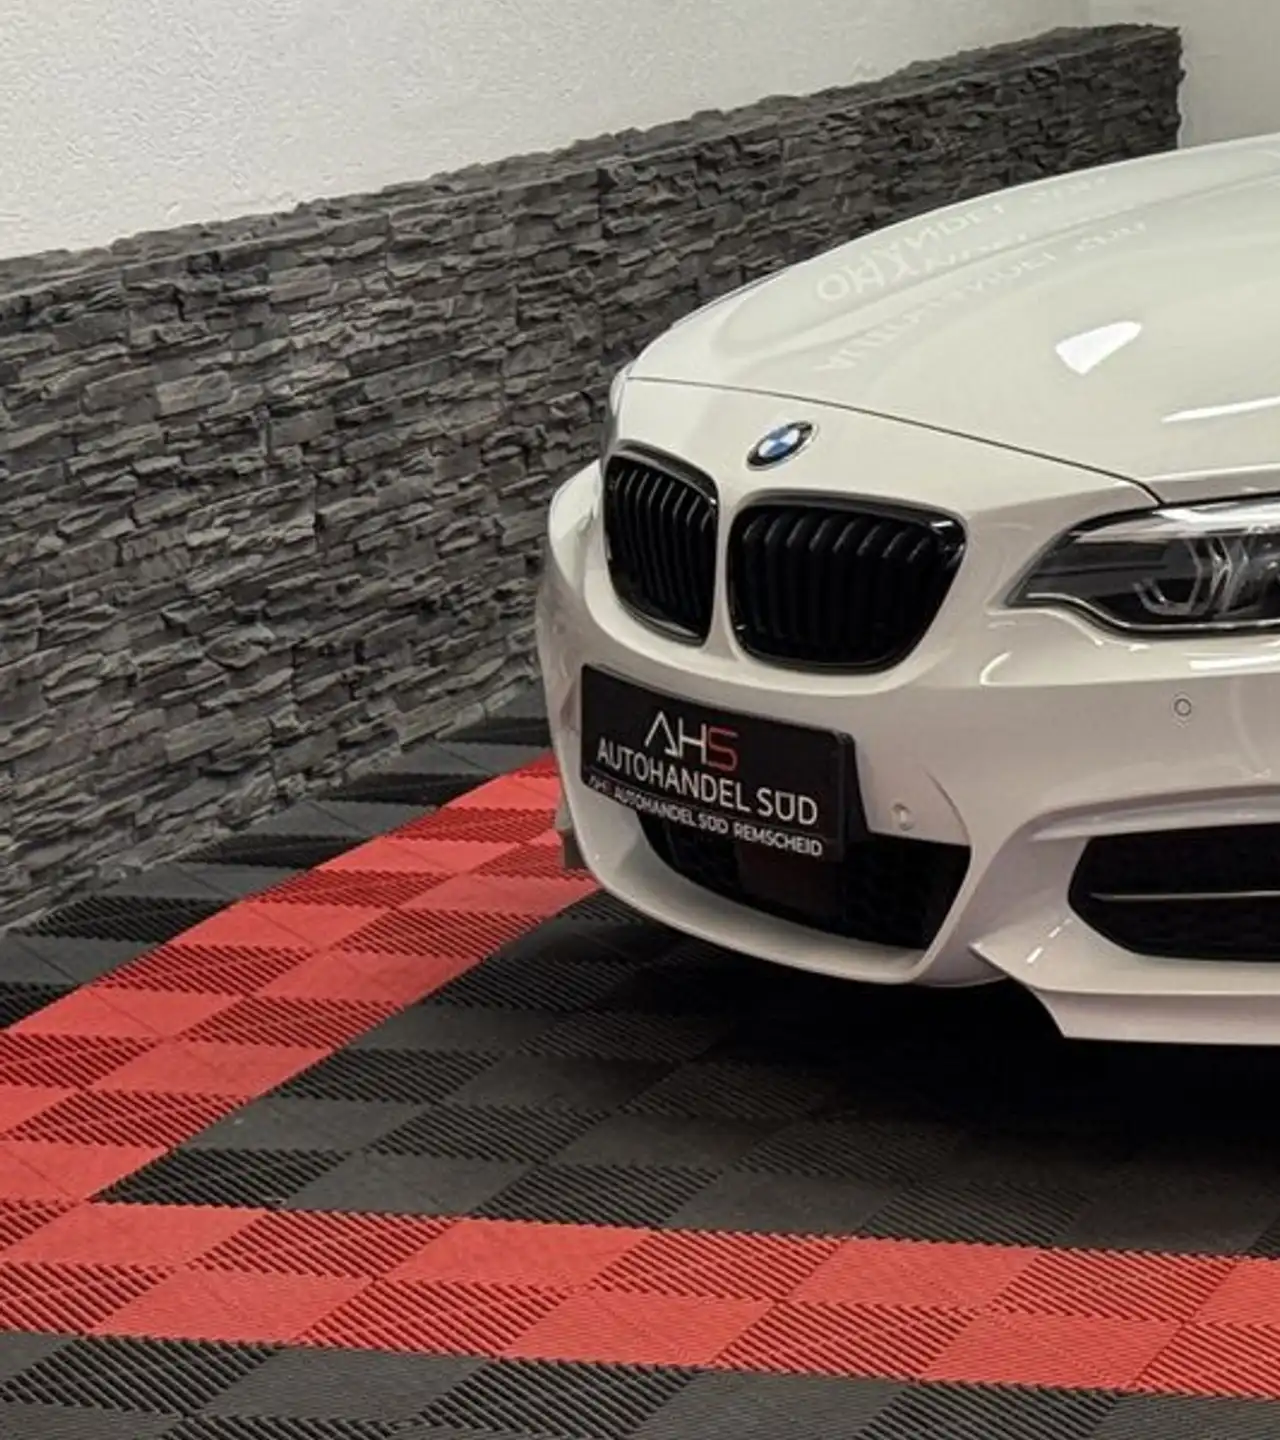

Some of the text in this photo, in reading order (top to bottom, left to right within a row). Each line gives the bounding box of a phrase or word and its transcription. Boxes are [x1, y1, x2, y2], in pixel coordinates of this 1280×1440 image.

[644, 711, 739, 772] AHS
[596, 737, 819, 827] AUTOHANDEL SÜD
[614, 786, 697, 828] AUTOHANDEL
[699, 812, 729, 835] SÜD
[733, 822, 824, 857] REMSCHEID
